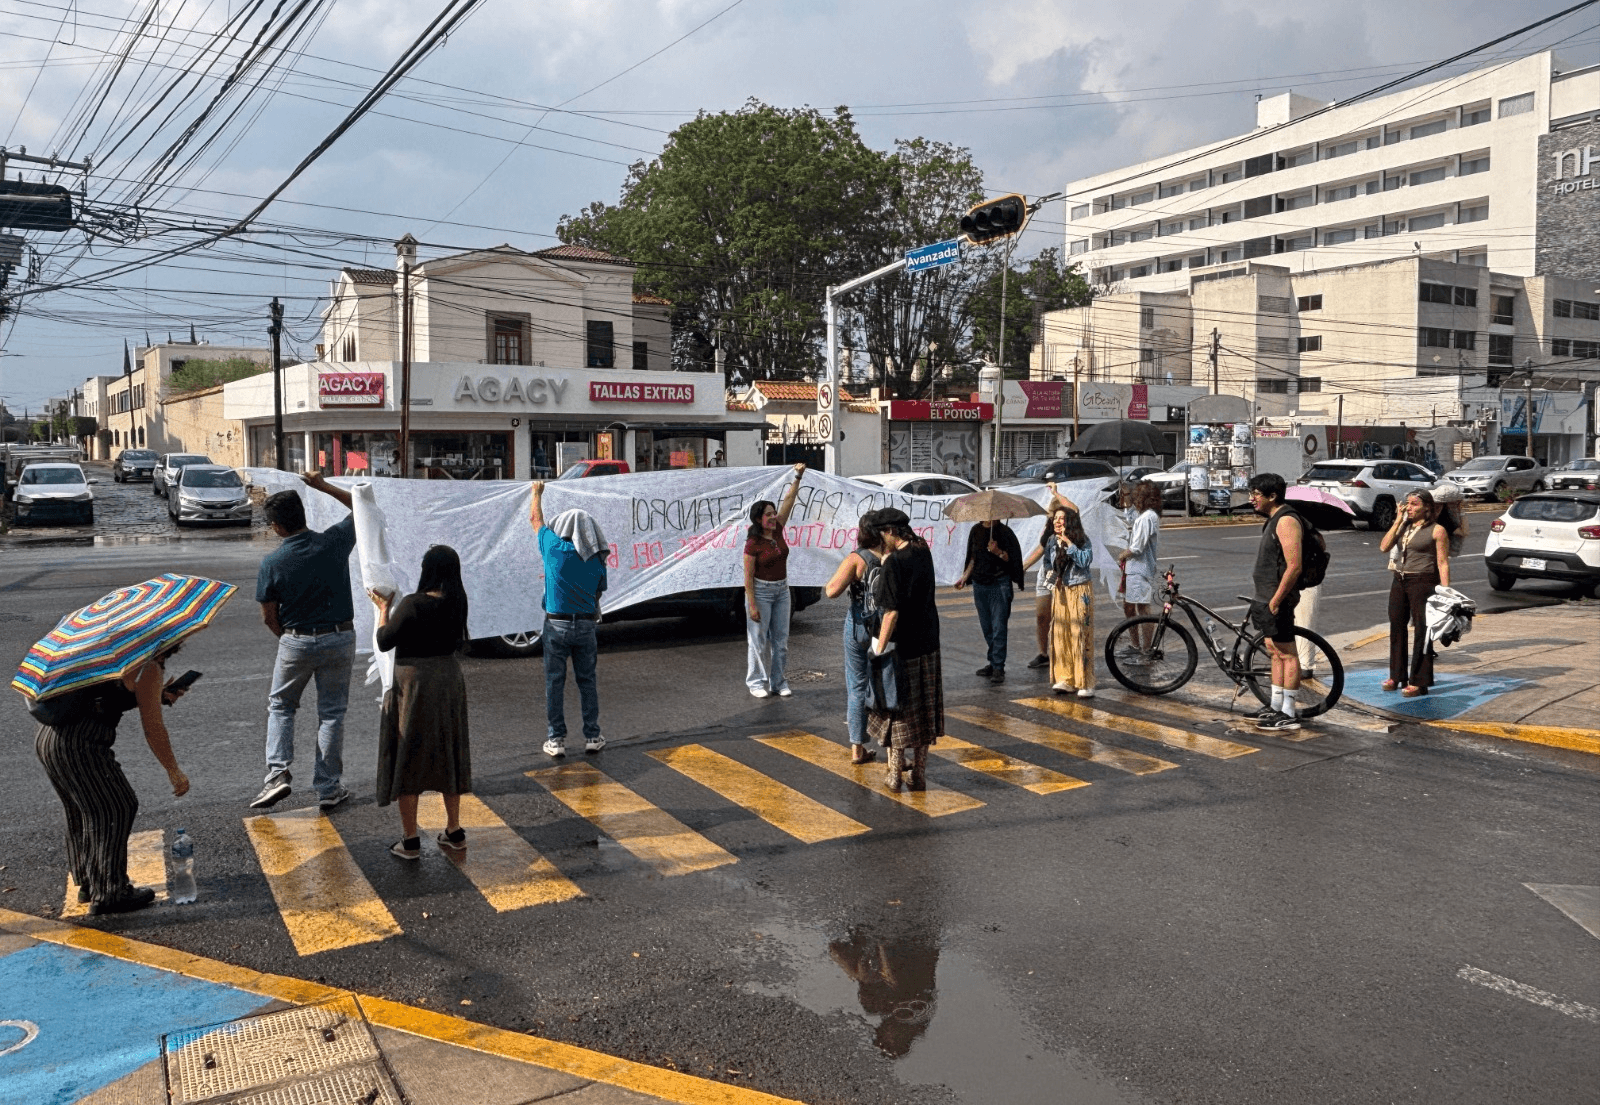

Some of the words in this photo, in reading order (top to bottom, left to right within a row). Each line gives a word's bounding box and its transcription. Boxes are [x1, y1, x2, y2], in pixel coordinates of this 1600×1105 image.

[907, 246, 958, 267] Avanzada
[319, 376, 373, 392] AGACY
[454, 375, 568, 404] AGACY
[592, 384, 640, 399] TALLAS
[644, 386, 692, 400] EXTRAS
[930, 408, 942, 419] EL
